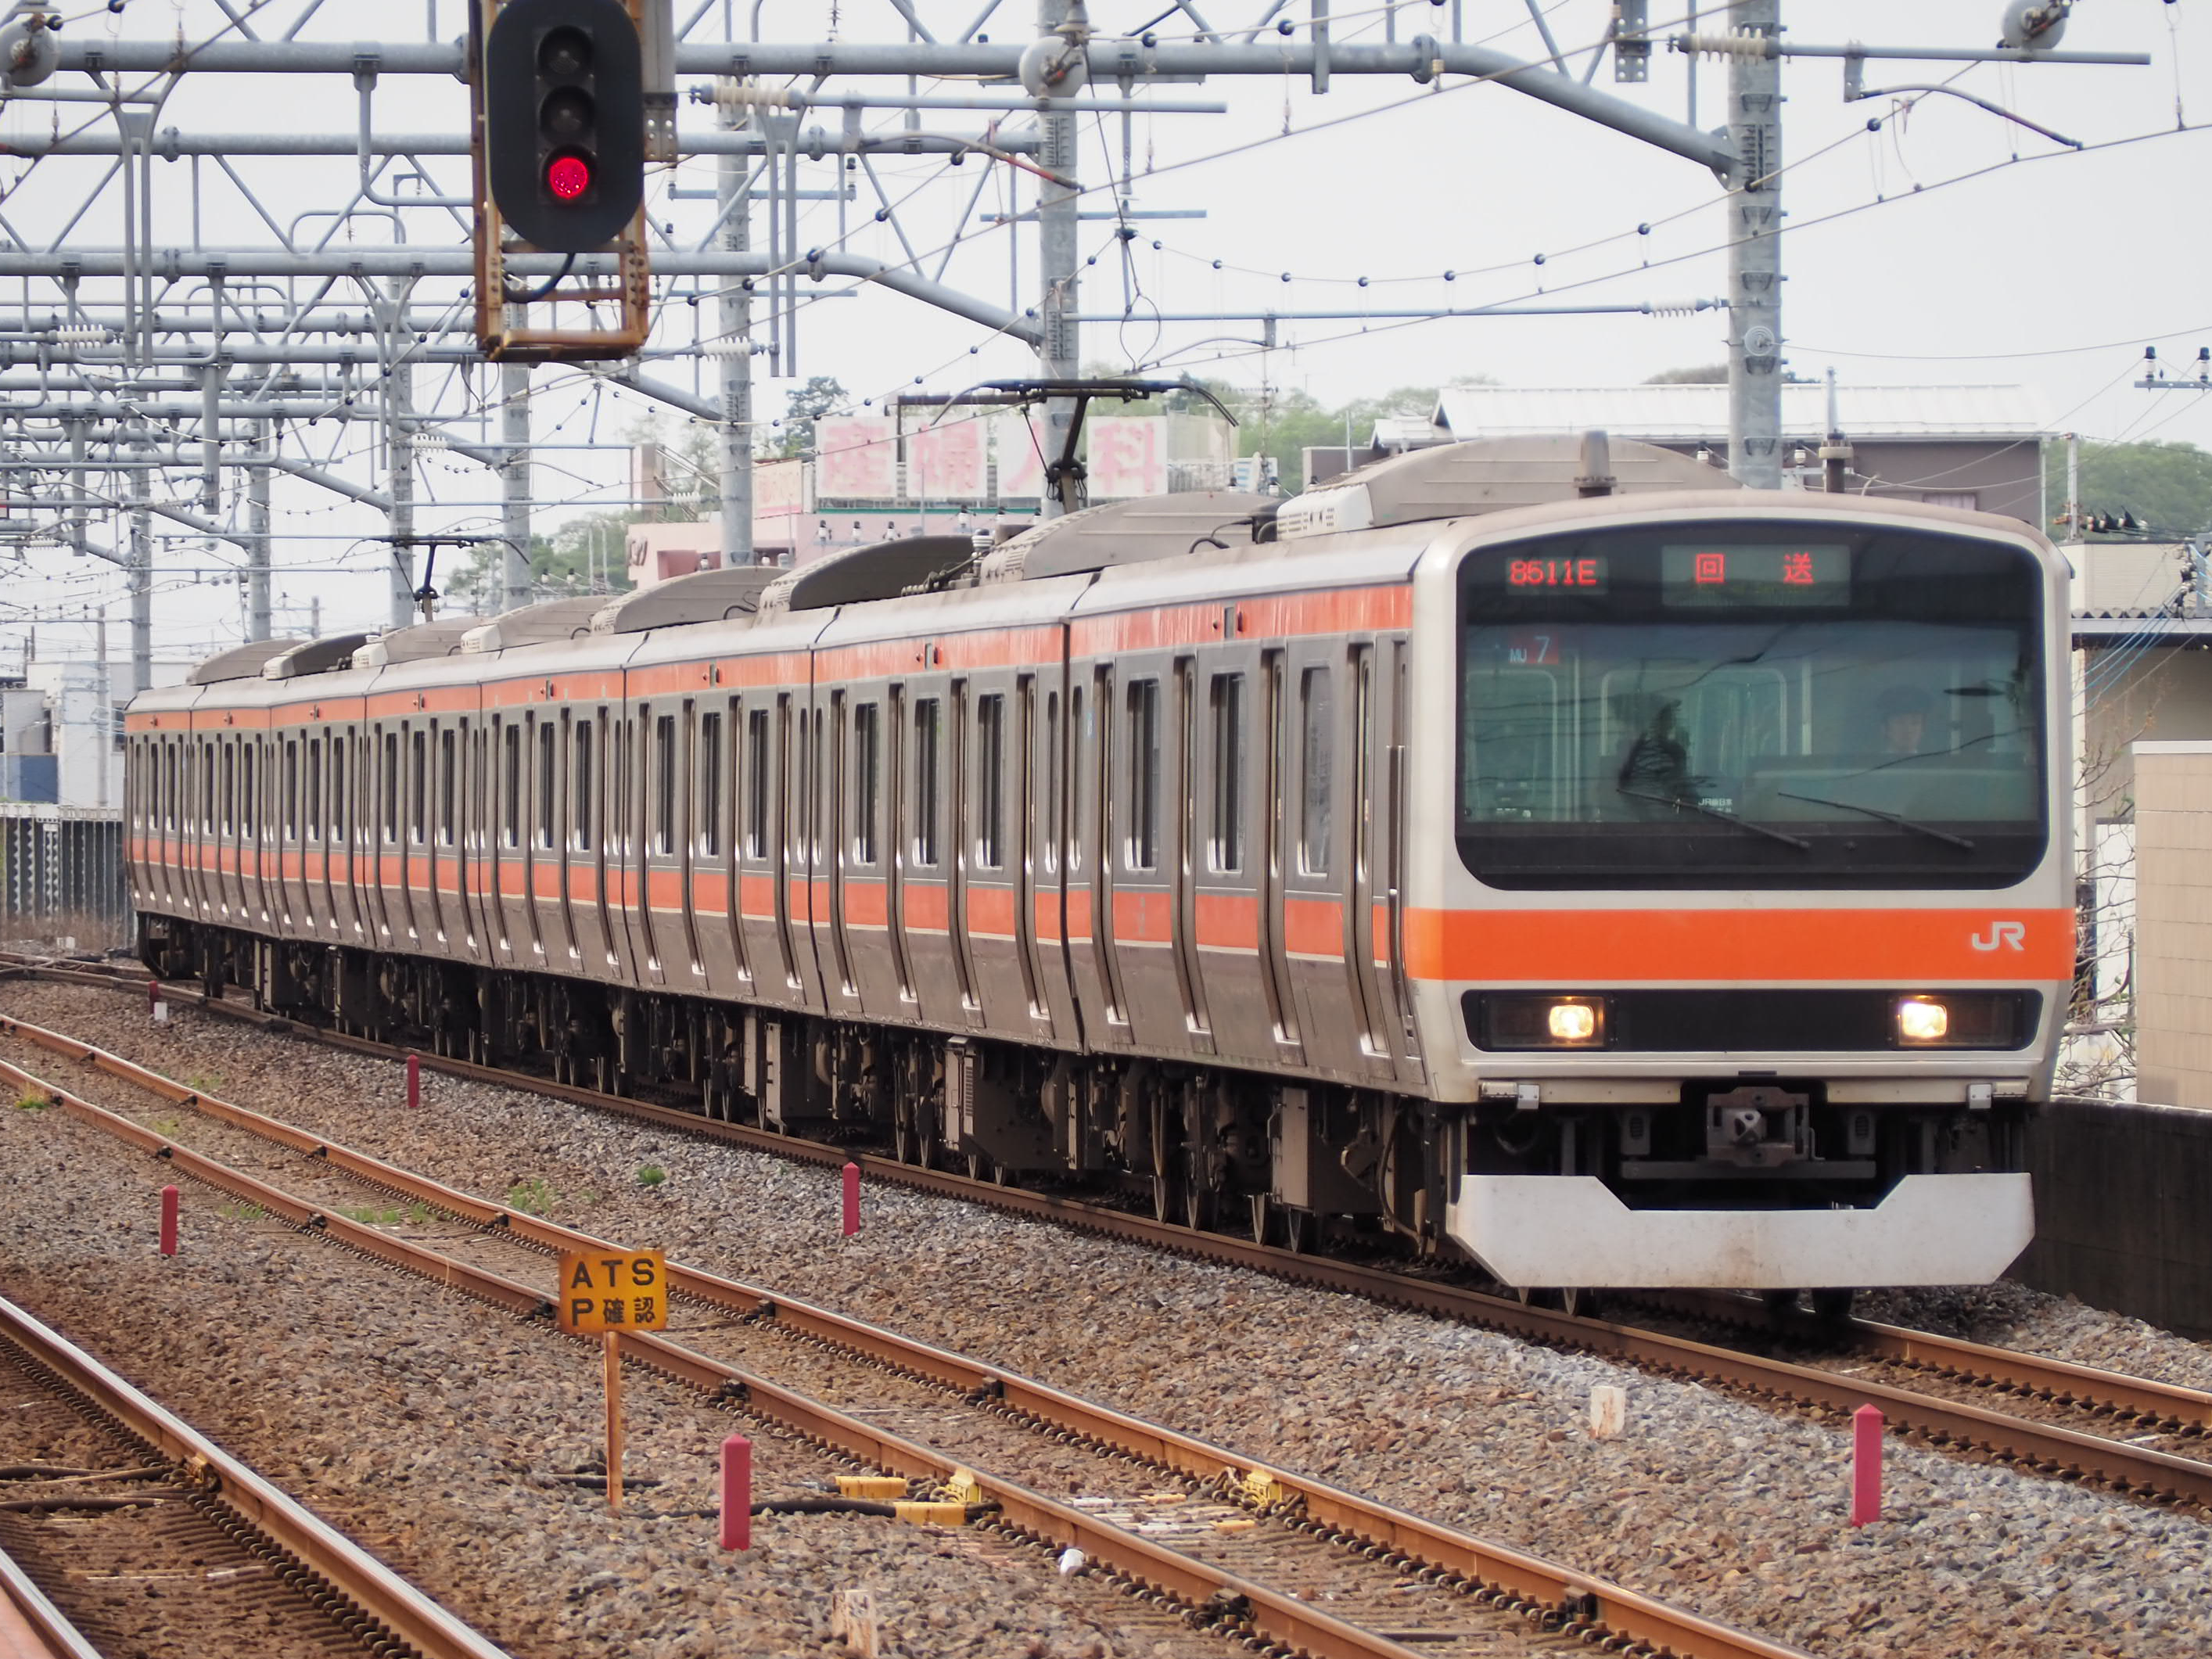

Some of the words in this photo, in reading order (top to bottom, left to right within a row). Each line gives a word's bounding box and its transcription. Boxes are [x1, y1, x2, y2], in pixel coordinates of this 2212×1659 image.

[1696, 552, 1813, 584] 回送
[1533, 635, 1550, 663] 7
[1972, 921, 2025, 951] JR
[571, 1258, 655, 1289] ATS
